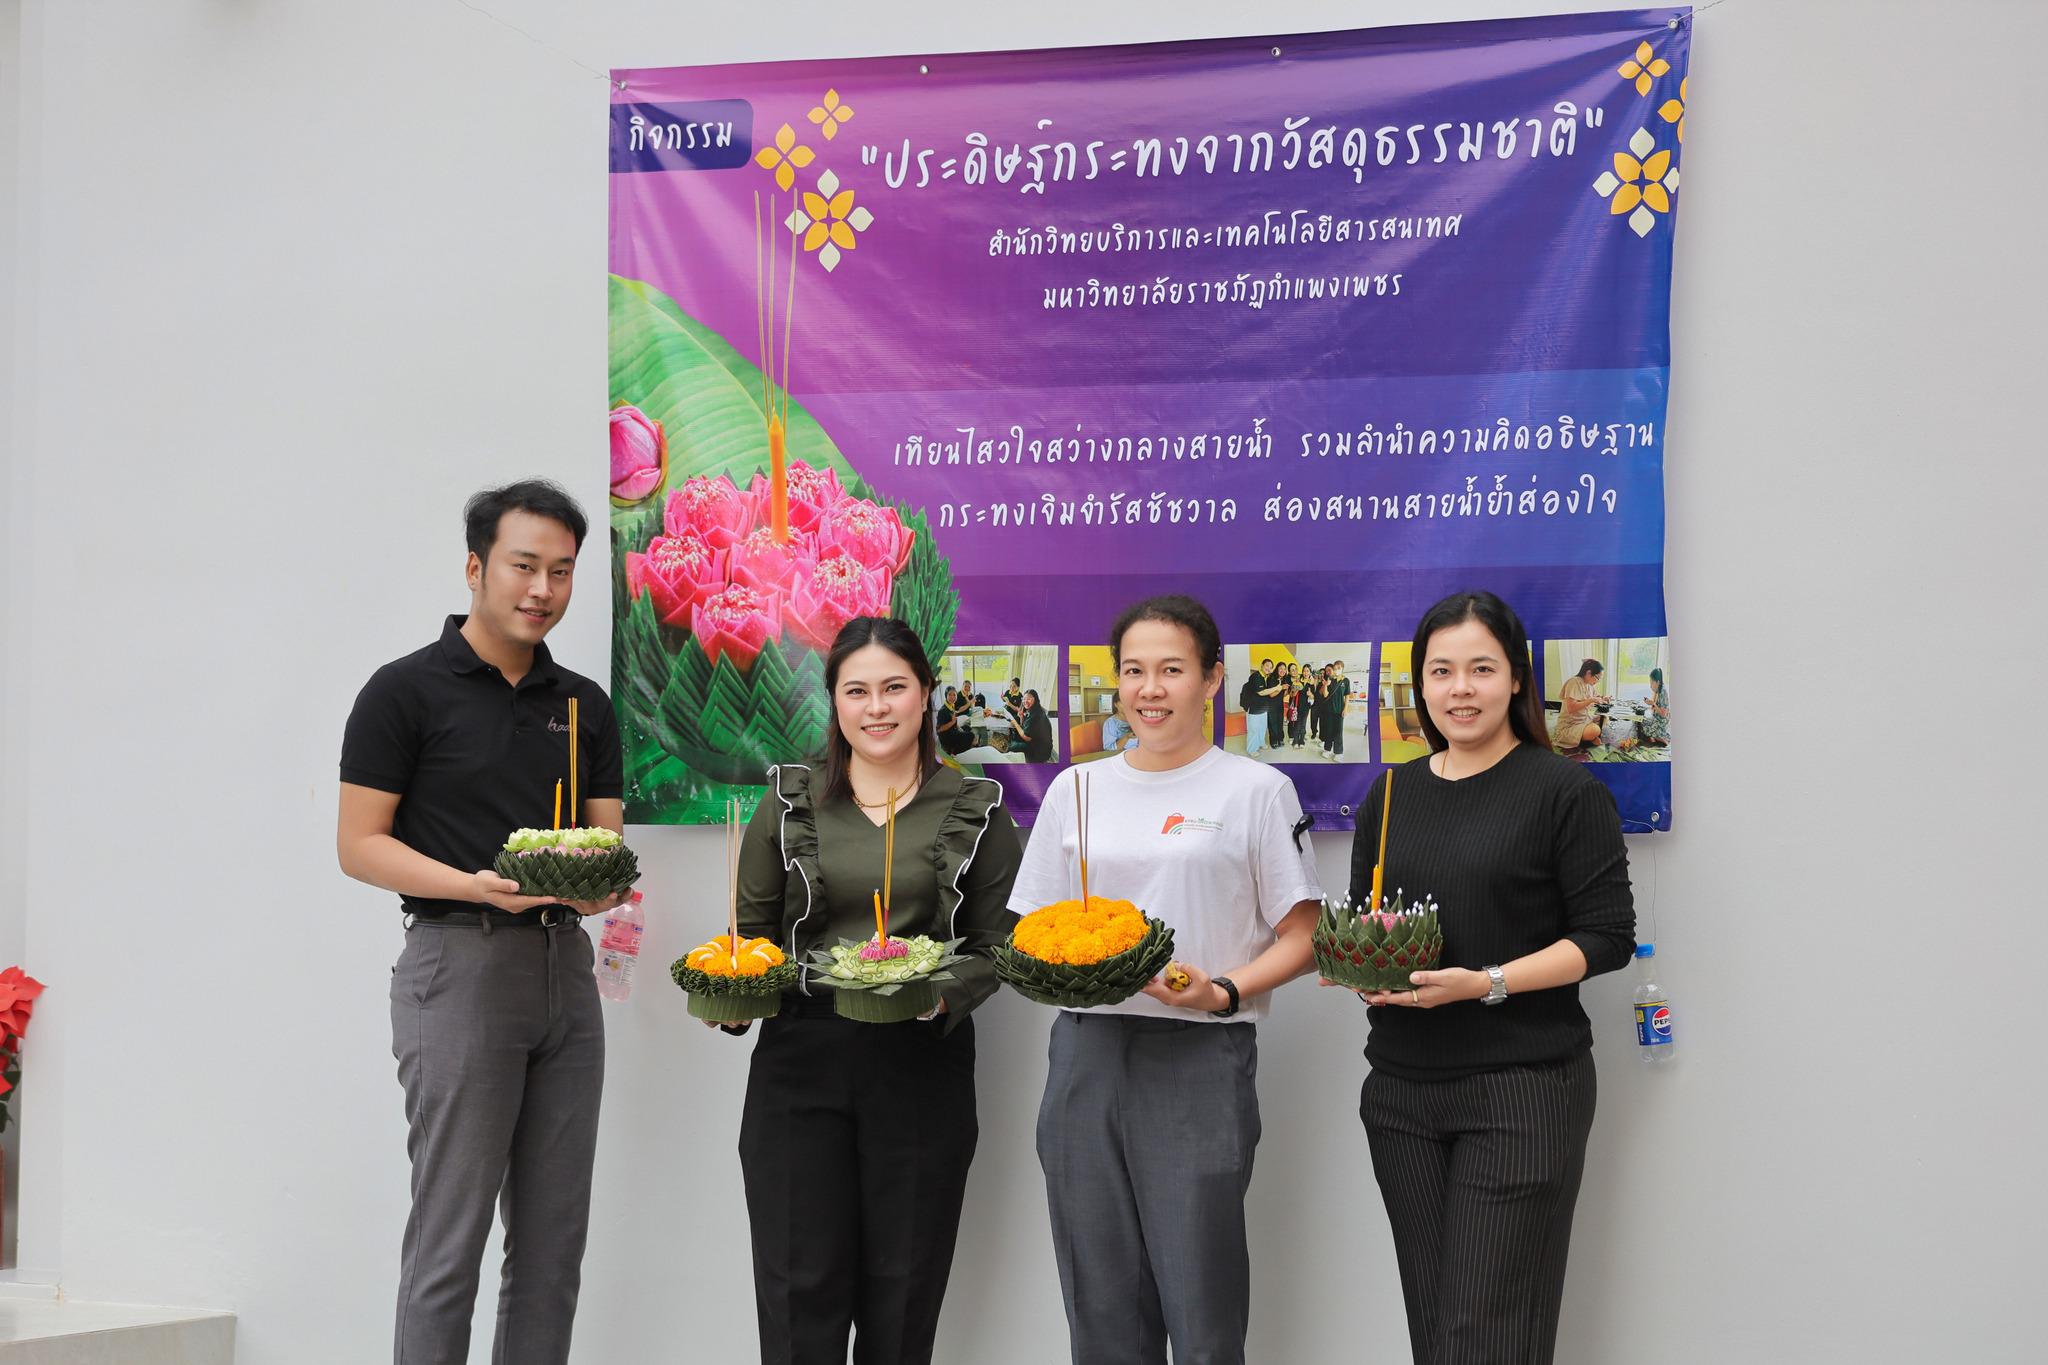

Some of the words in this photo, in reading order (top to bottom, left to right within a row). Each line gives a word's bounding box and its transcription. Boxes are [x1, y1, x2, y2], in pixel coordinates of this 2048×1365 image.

[629, 115, 733, 151] กิจกรรม
[988, 208, 1463, 258] สำนักวิทยบริการและเทคโนโลยีสารสนเทศ
[1042, 272, 1404, 310] มหาวิทยาลัยราชภัฏกำแพงเพชร
[893, 418, 1273, 467] เทียนไสวใจสว่างกลางสายน้ำ
[1300, 414, 1654, 458] รวมลำนำความคิดอธิษฐาน
[939, 491, 1238, 528] กระทงเจิมจำรัสชัชวาล
[1263, 473, 1618, 522] ส่องสนานสายน้ำย้ำส่องใจ
